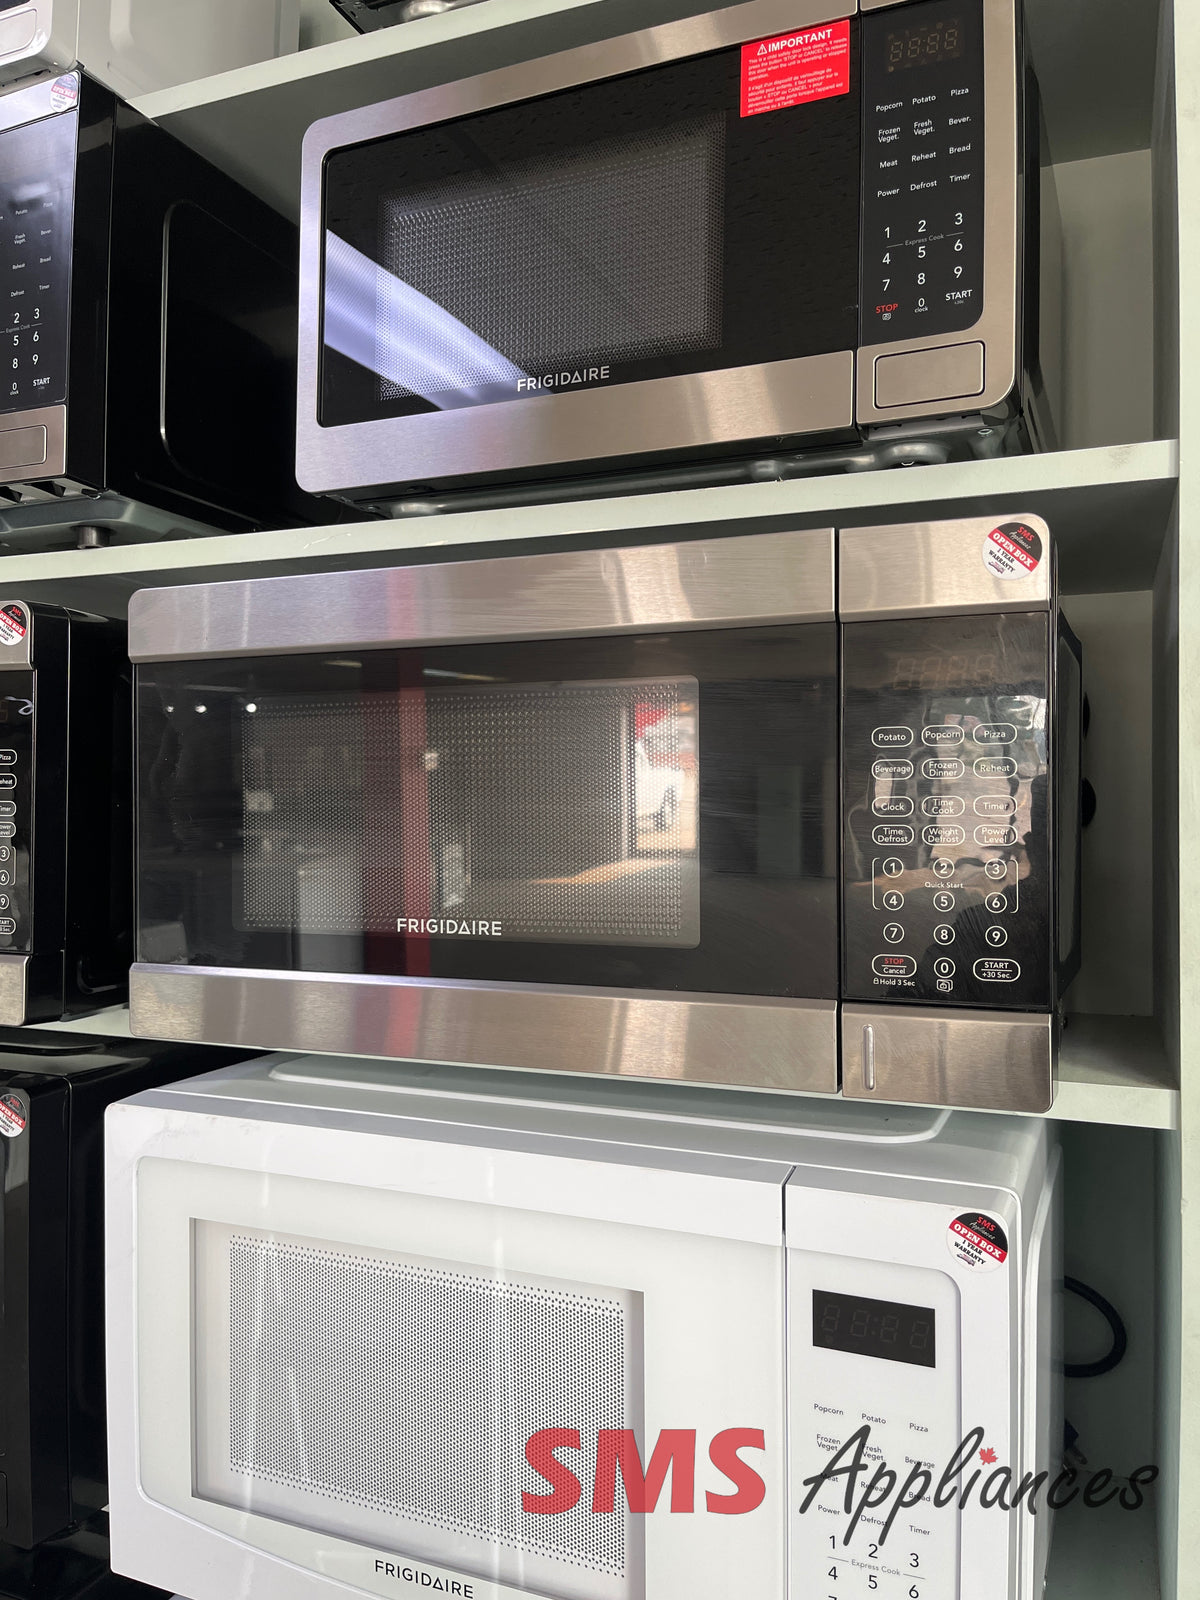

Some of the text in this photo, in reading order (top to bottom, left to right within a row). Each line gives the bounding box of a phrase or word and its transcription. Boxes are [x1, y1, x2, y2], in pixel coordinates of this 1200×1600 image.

[768, 29, 832, 52] IMPORTANT
[950, 88, 969, 96] Pizza
[912, 95, 936, 104] Potato
[876, 102, 903, 112] Popcorn
[914, 119, 932, 128] Fresh
[948, 116, 972, 126] Bever.
[878, 127, 900, 136] Frozen
[914, 126, 935, 136] Veget.
[878, 134, 899, 143] Veget.
[949, 144, 971, 154] Bread
[911, 152, 936, 162] Reheat
[880, 160, 898, 168] Meat
[950, 173, 970, 182] Timer
[910, 180, 938, 191] Defrost
[878, 188, 900, 198] Power
[954, 212, 963, 225] 3
[918, 220, 926, 232] 2
[884, 226, 890, 238] 1
[954, 239, 963, 252] 6
[918, 246, 926, 258] 5
[882, 252, 891, 264] 4
[954, 266, 962, 278] 9
[918, 272, 926, 285] 8
[882, 278, 890, 292] 7
[945, 289, 972, 300] START
[918, 298, 925, 307] 0
[34, 308, 40, 319] 3
[876, 303, 898, 314] STOP
[14, 312, 20, 324] 2
[14, 335, 18, 346] 5
[33, 331, 39, 342] 6
[12, 358, 18, 368] 8
[32, 354, 38, 365] 9
[33, 377, 50, 386] START
[517, 366, 610, 392] FRIGIDAIRE
[12, 382, 18, 390] 0
[992, 532, 1034, 567] OPEN BOX
[989, 550, 1016, 572] WARRANTY
[1001, 551, 1014, 564] YEAR
[925, 730, 960, 740] Popcorn
[875, 765, 911, 774] Beverage
[928, 761, 958, 769] Frozen
[980, 764, 1010, 772] Reheat
[880, 802, 904, 810] Clock
[928, 828, 958, 836] Weight
[2, 850, 6, 858] 3
[890, 862, 896, 874] 1
[940, 863, 948, 874] 2
[992, 864, 1000, 874] 3
[890, 895, 898, 906] 4
[940, 896, 948, 907] 5
[992, 897, 1000, 908] 6
[397, 918, 502, 936] FRIGIDAIRE
[890, 928, 898, 938] 7
[940, 930, 948, 940] 8
[992, 931, 1000, 942] 9
[940, 962, 949, 973] 0
[977, 1216, 996, 1232] SMS
[954, 1224, 1002, 1258] OPEN BOX
[954, 1242, 986, 1264] WARRANTY
[967, 1242, 982, 1255] YEAR
[814, 1404, 844, 1416] Popcorn
[862, 1414, 886, 1424] Potato
[910, 1423, 928, 1432] Pizza
[816, 1434, 840, 1444] Frozen
[818, 1505, 840, 1516] Power
[860, 1515, 888, 1526] Defrost
[910, 1525, 930, 1536] Timer
[830, 1536, 835, 1549] 1
[868, 1544, 878, 1558] 2
[910, 1553, 919, 1568] 3
[828, 1566, 838, 1580] 4
[852, 1560, 900, 1576] Express Cook
[375, 1560, 474, 1599] FRIGIDAIRE
[868, 1575, 878, 1589] 5
[908, 1585, 919, 1598] 6
